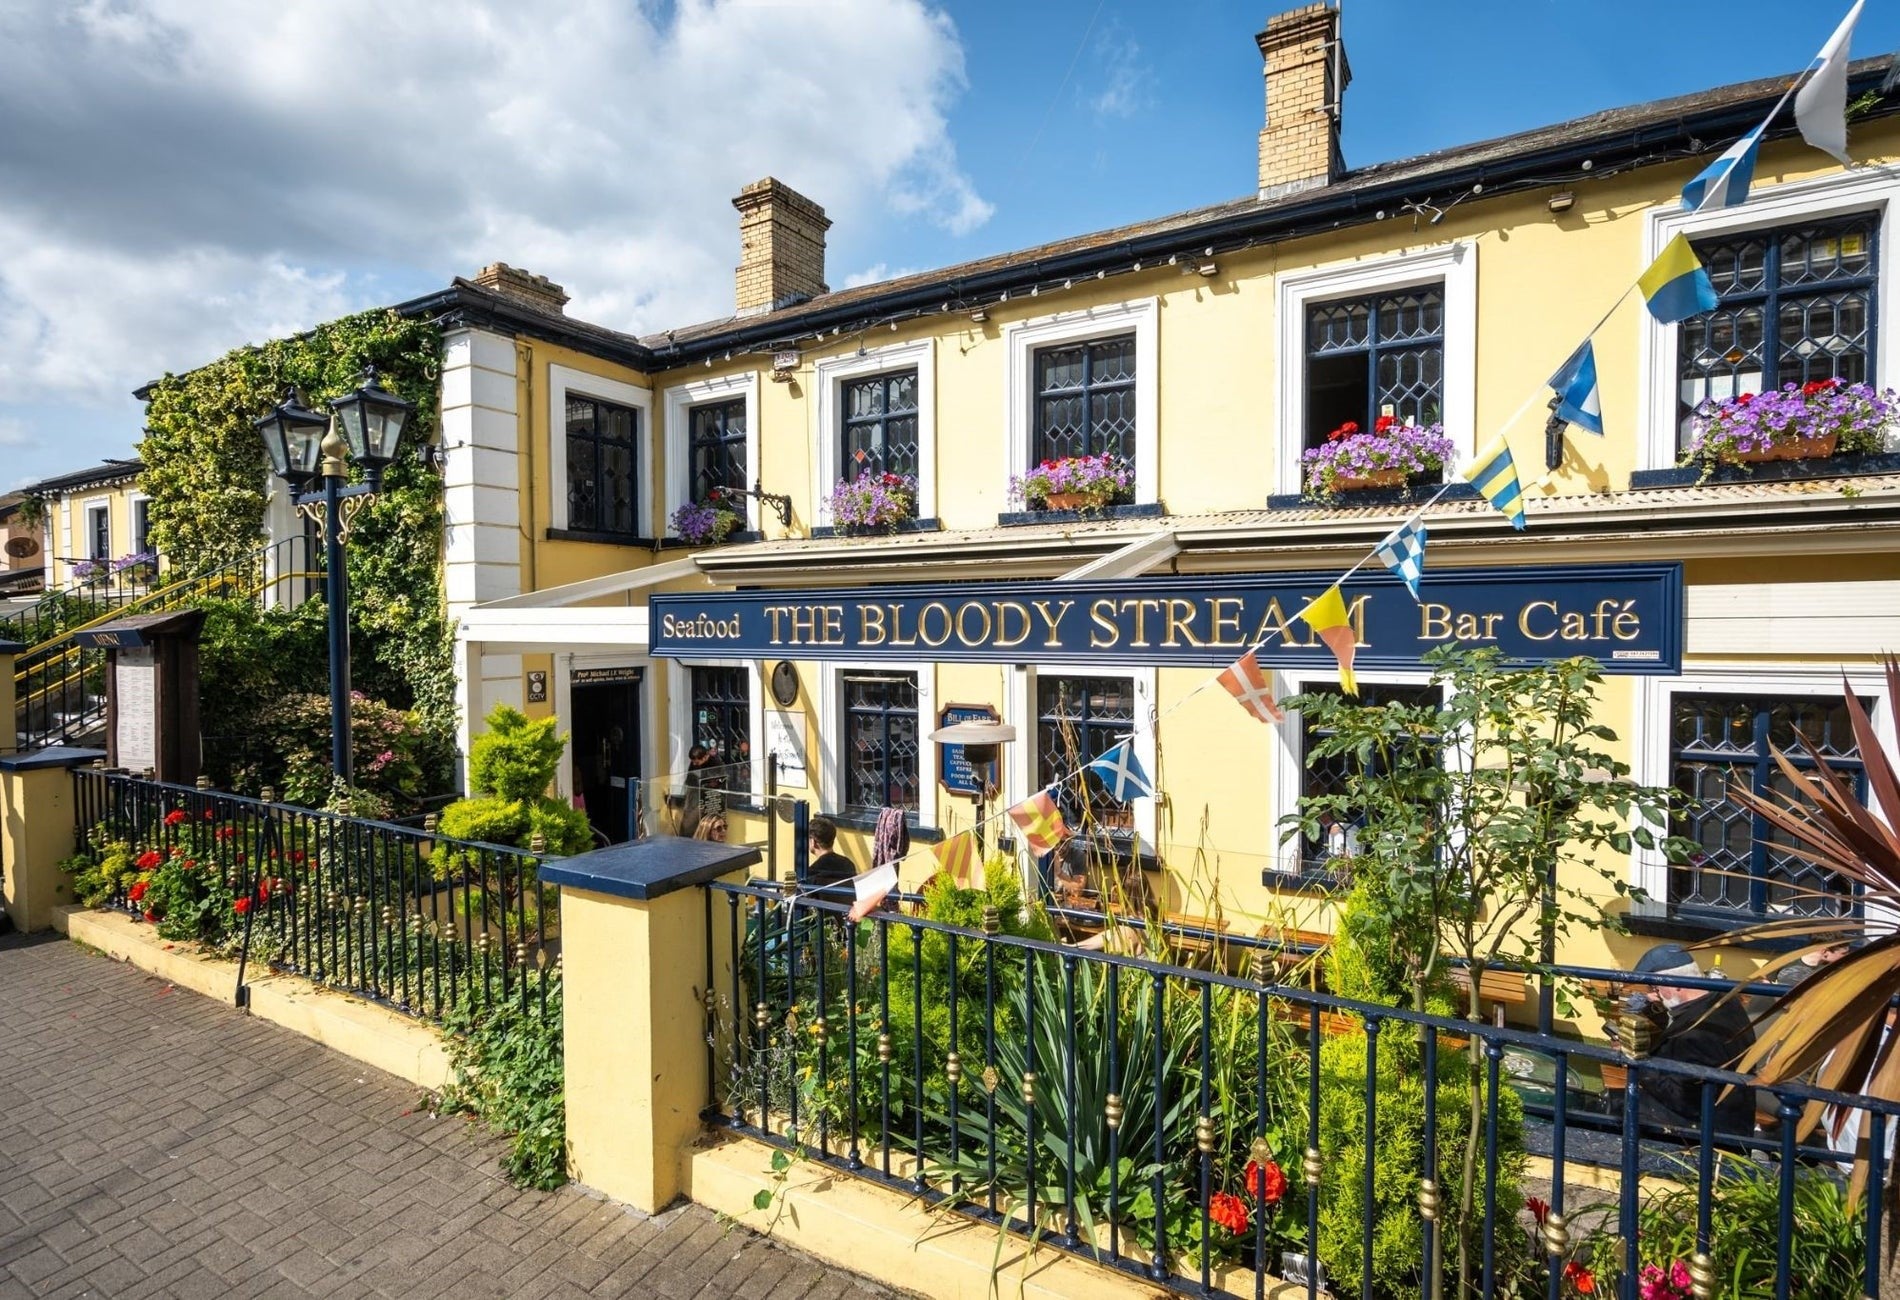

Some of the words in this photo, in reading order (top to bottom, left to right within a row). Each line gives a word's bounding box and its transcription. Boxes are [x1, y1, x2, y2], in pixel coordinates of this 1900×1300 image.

[662, 613, 741, 639] Seafood
[764, 606, 845, 646] THE
[856, 601, 1075, 647] BLOODY
[1417, 603, 1504, 641] Bar
[1518, 599, 1640, 641] Café
